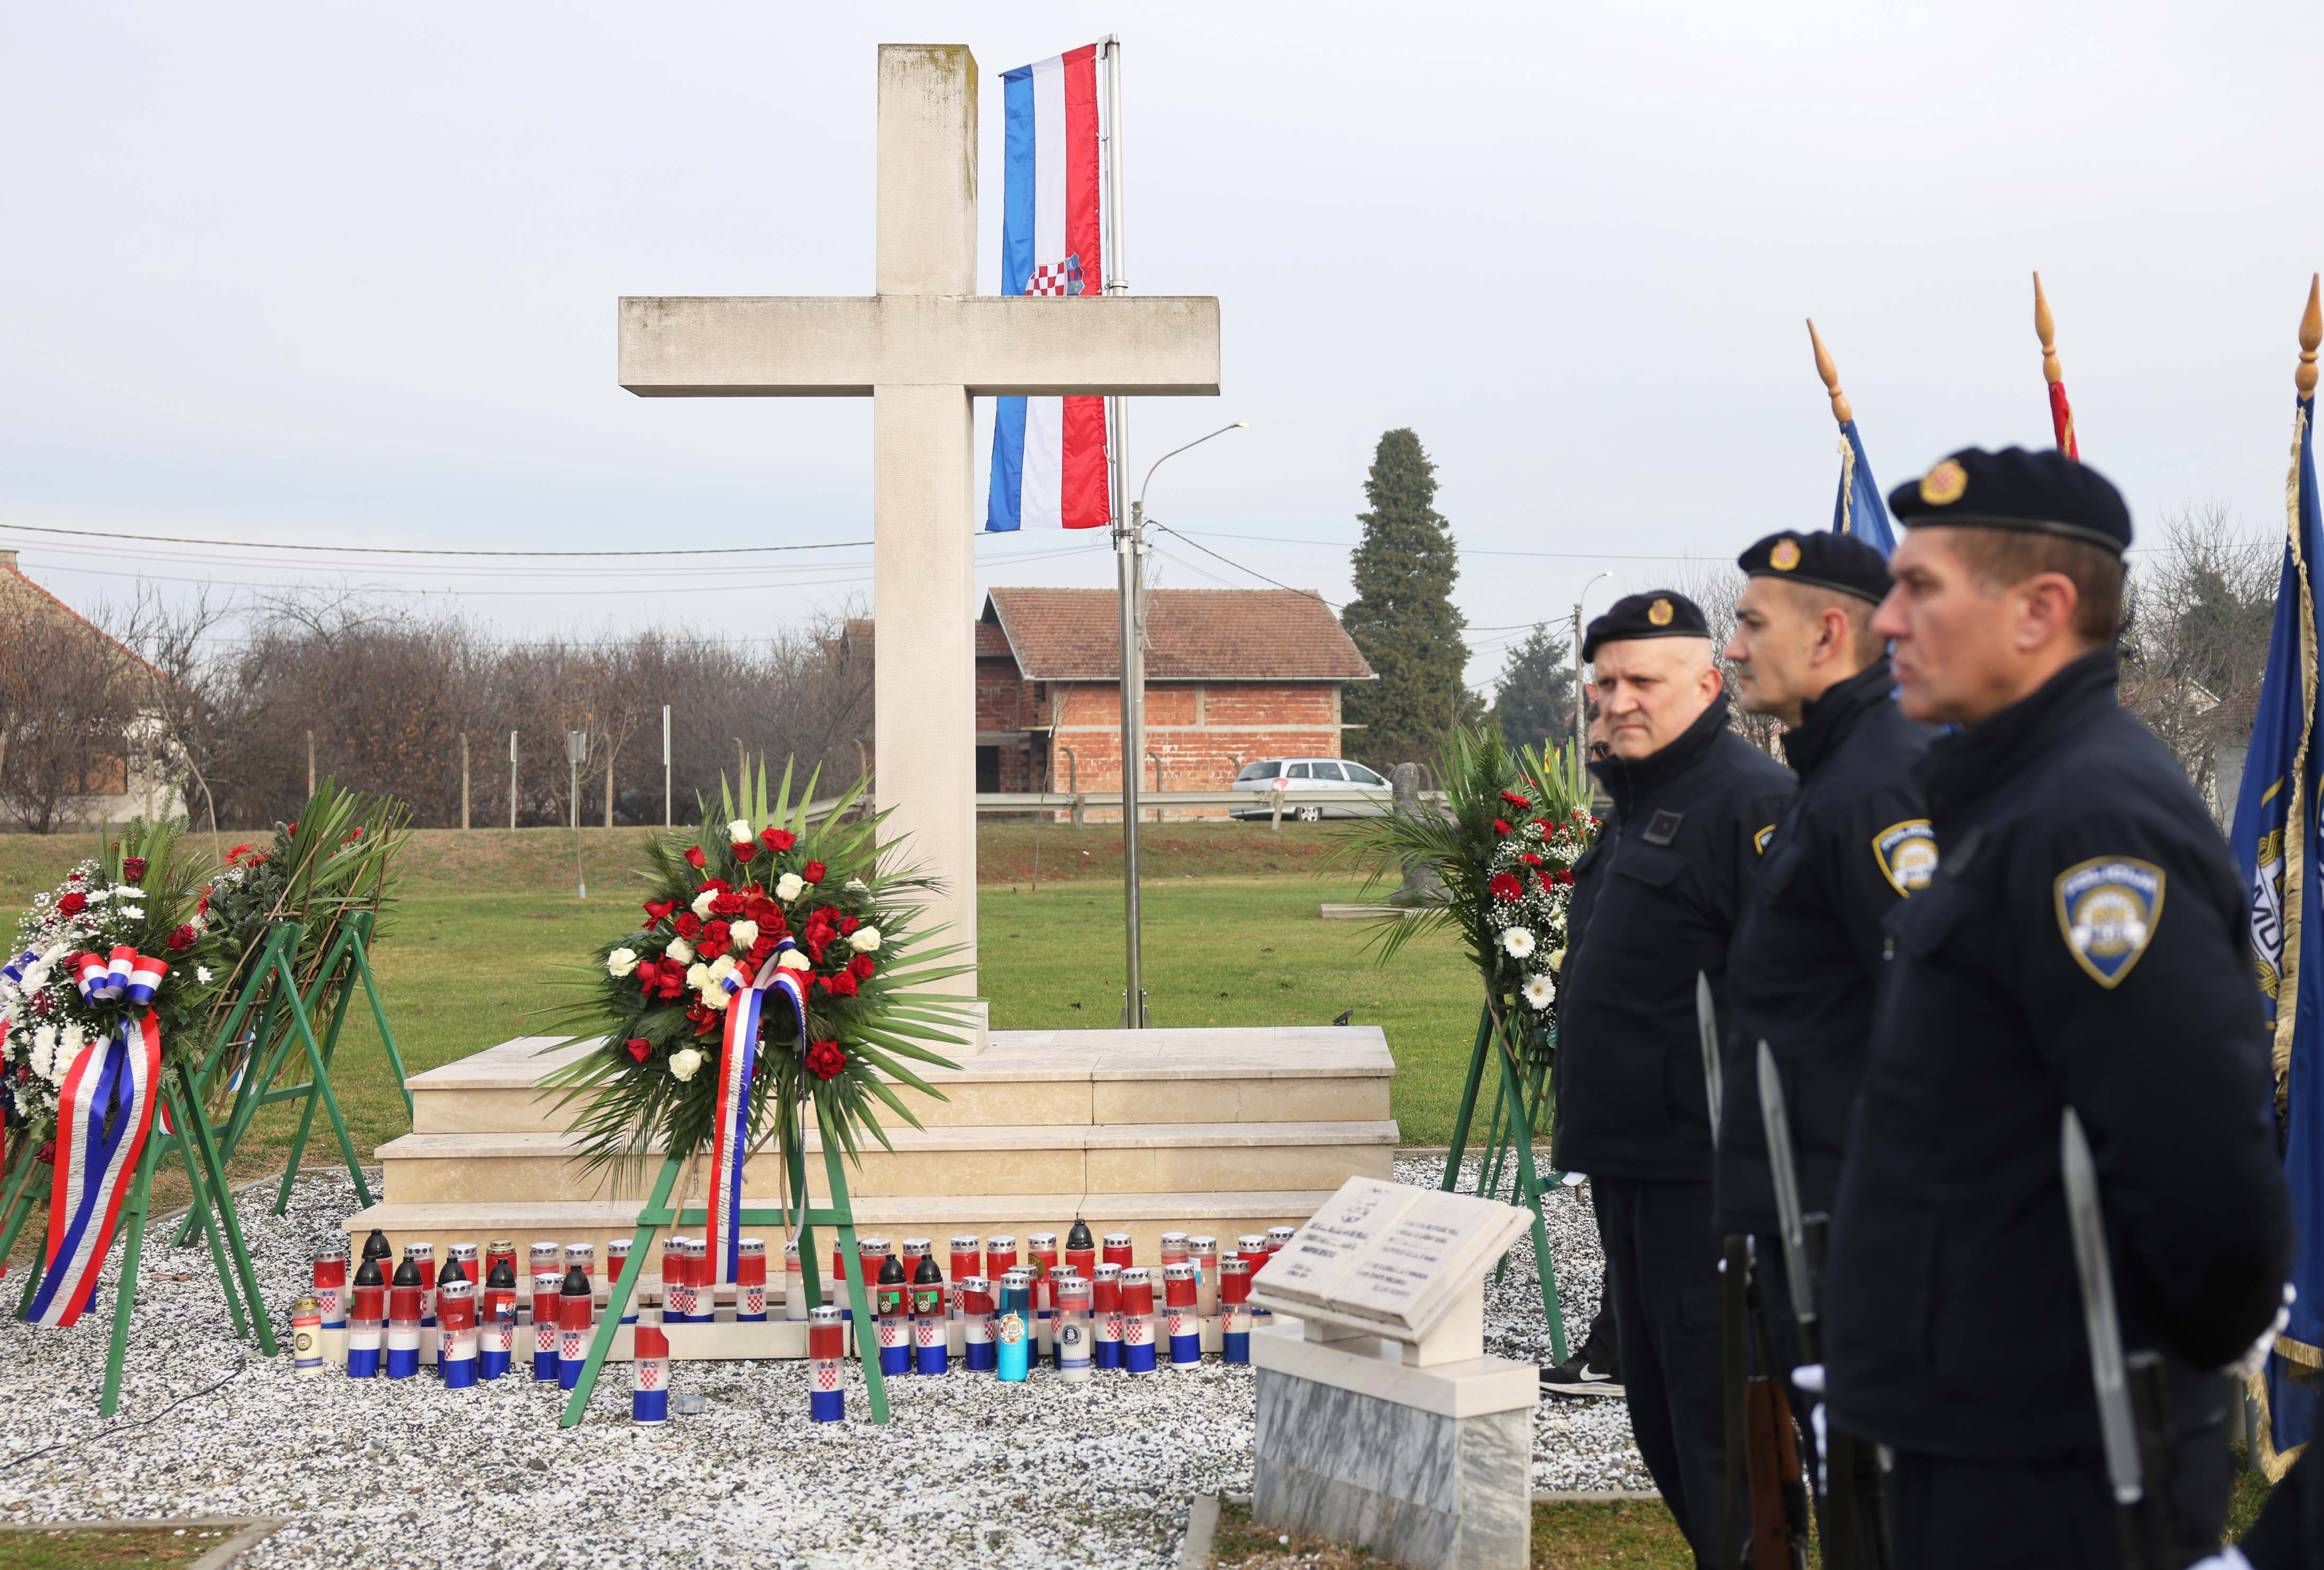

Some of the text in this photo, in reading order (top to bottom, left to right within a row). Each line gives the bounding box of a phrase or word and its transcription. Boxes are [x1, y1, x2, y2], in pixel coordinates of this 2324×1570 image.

[2252, 885, 2284, 964] MU
[715, 1052, 747, 1245] U SPOMEN PALIM HEROJIMA
